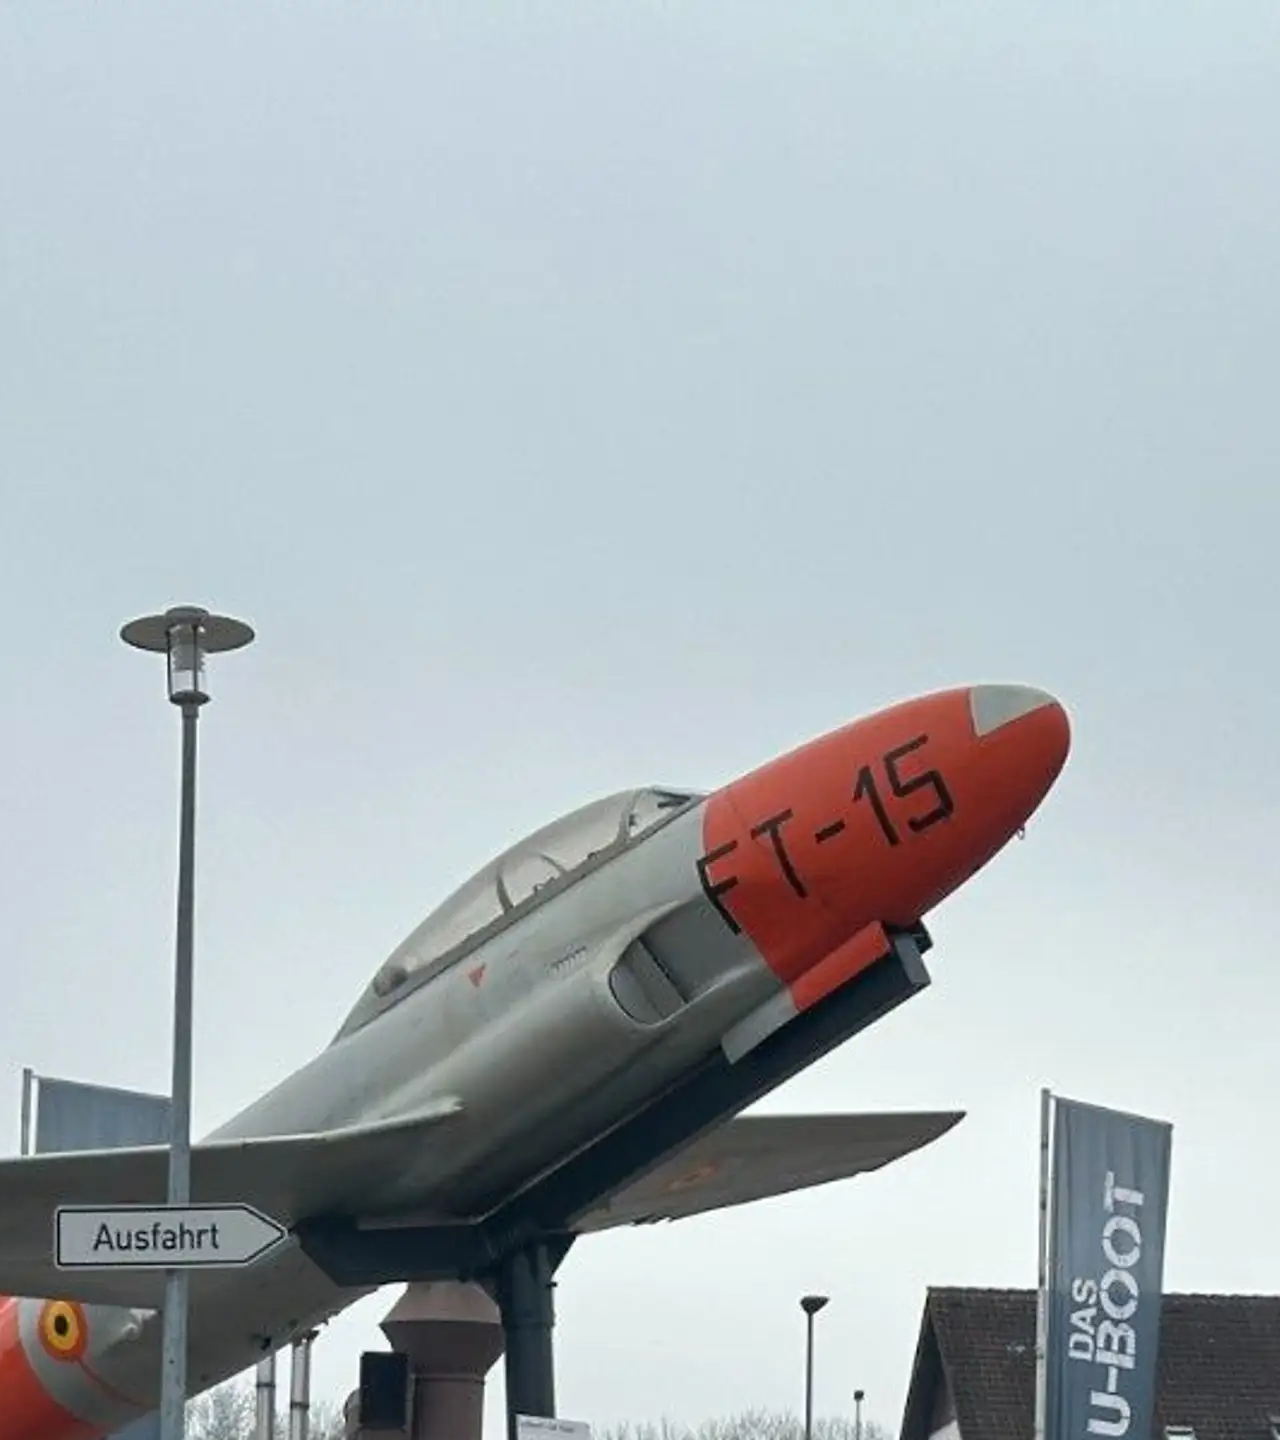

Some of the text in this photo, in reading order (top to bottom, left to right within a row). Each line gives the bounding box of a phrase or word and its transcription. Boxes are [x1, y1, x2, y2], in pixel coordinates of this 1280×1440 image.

[696, 735, 954, 936] FT-15
[93, 1222, 219, 1251] Ausfahrt
[1086, 1170, 1144, 1437] U-BOOT
[1068, 1277, 1098, 1362] DAS
